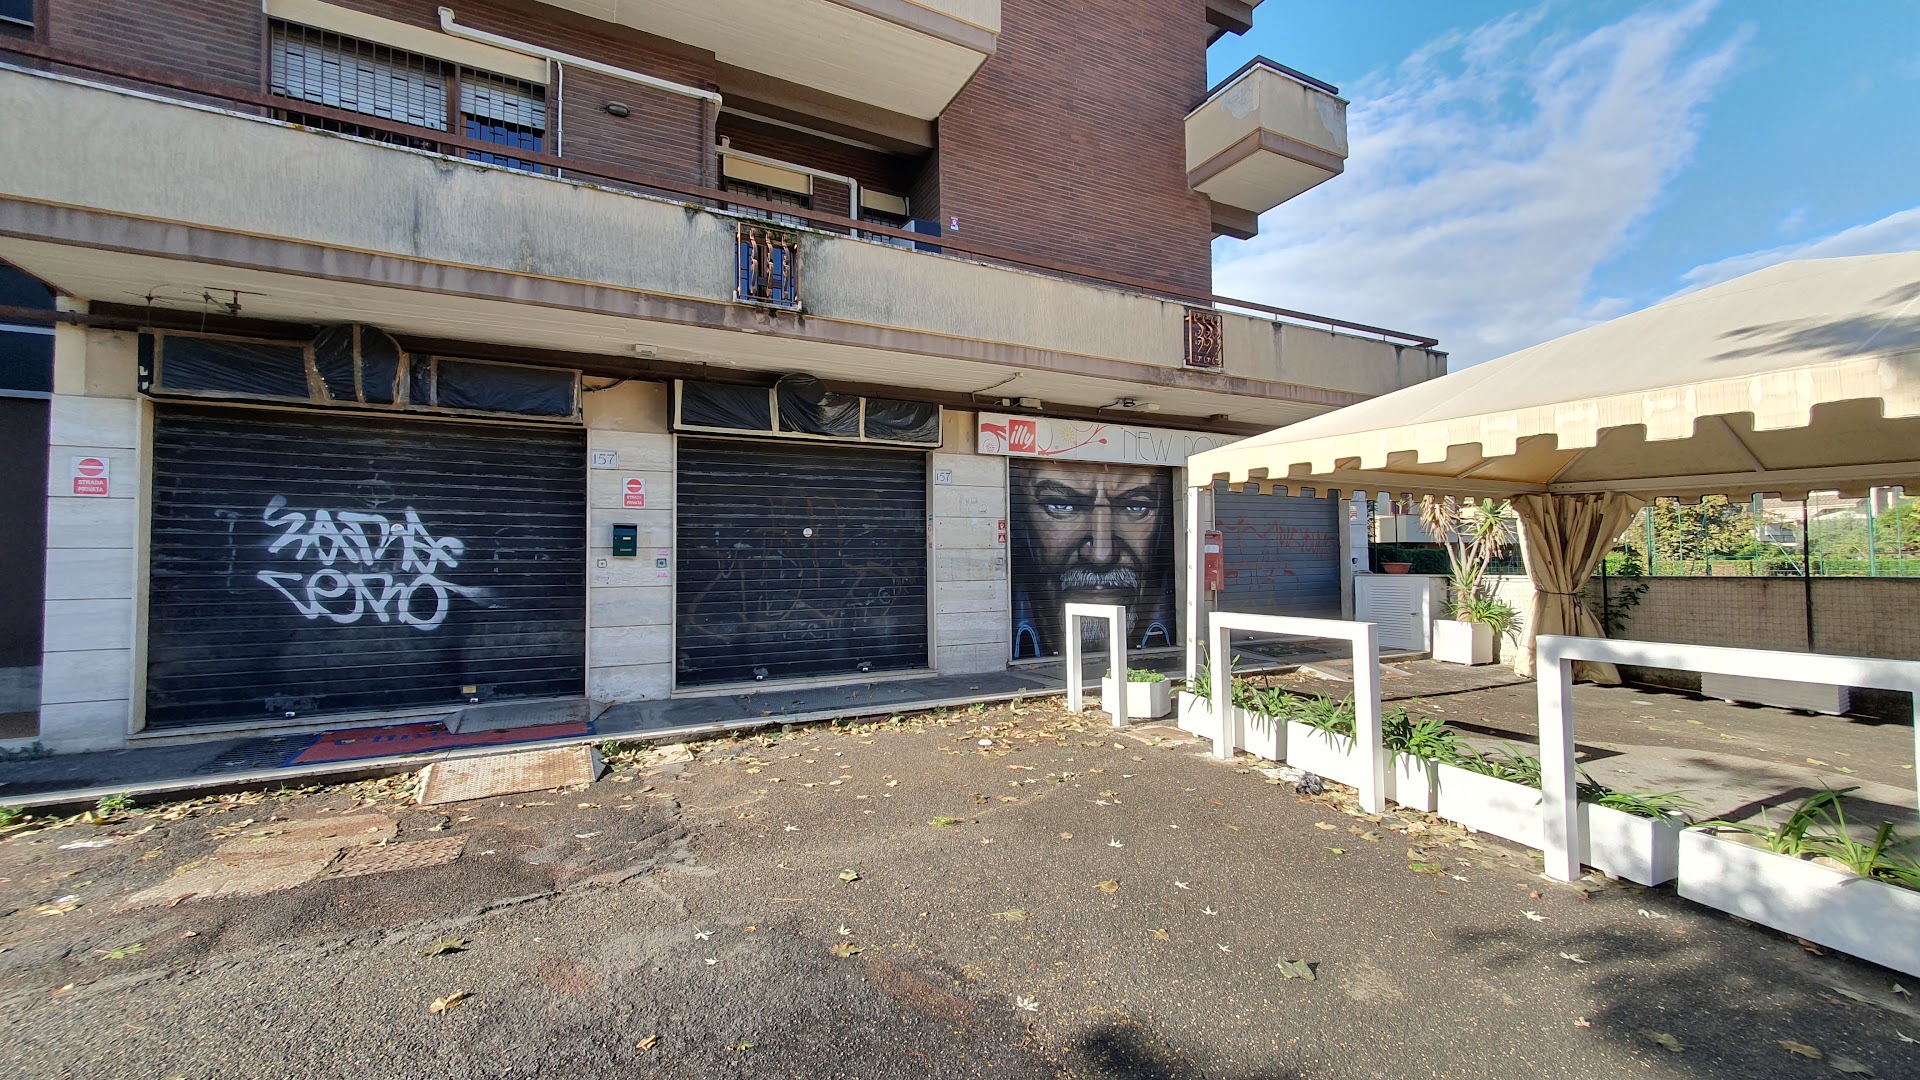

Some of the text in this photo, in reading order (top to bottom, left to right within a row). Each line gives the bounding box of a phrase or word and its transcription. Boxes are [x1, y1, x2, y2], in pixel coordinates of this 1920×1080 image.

[1010, 424, 1034, 450] illy
[1124, 430, 1172, 462] NEW
[593, 453, 616, 465] 157
[936, 472, 951, 482] 157
